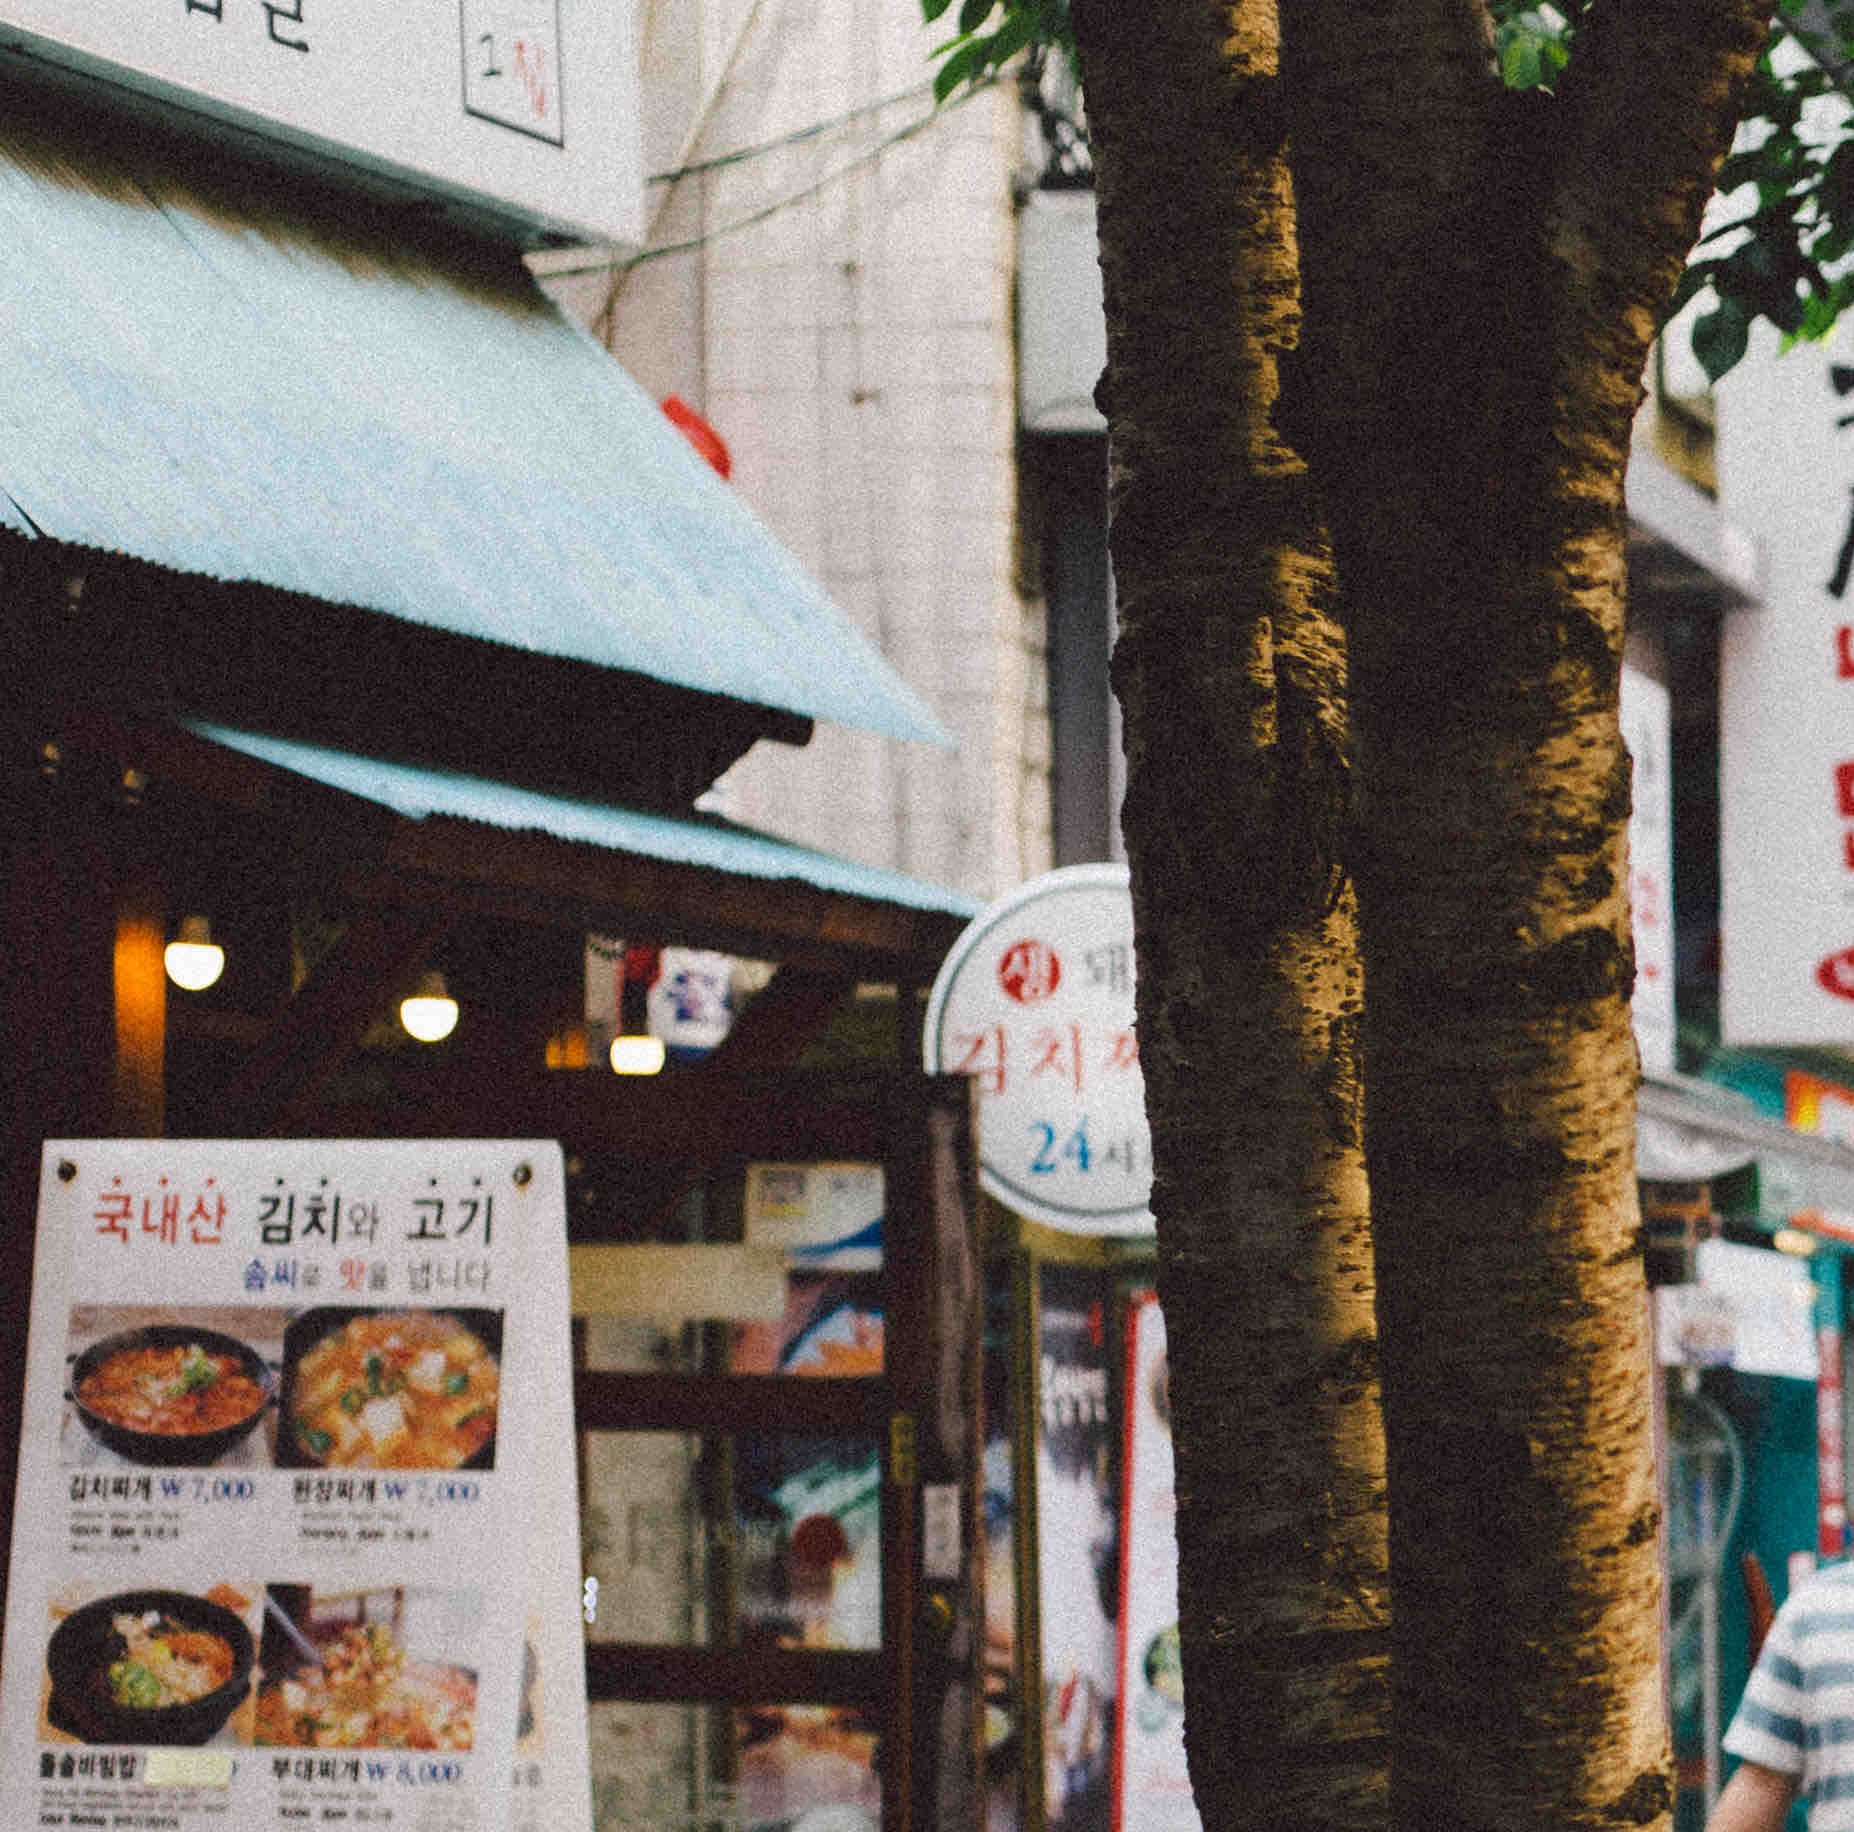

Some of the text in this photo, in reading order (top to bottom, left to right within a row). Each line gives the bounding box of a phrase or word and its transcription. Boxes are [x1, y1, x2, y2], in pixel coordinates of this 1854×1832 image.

[93, 1192, 496, 1246] 국내산 김치와 고기
[68, 1475, 153, 1502] 김치찌개
[292, 1478, 378, 1505] 된장찌개
[272, 1757, 362, 1783] 부대찌개
